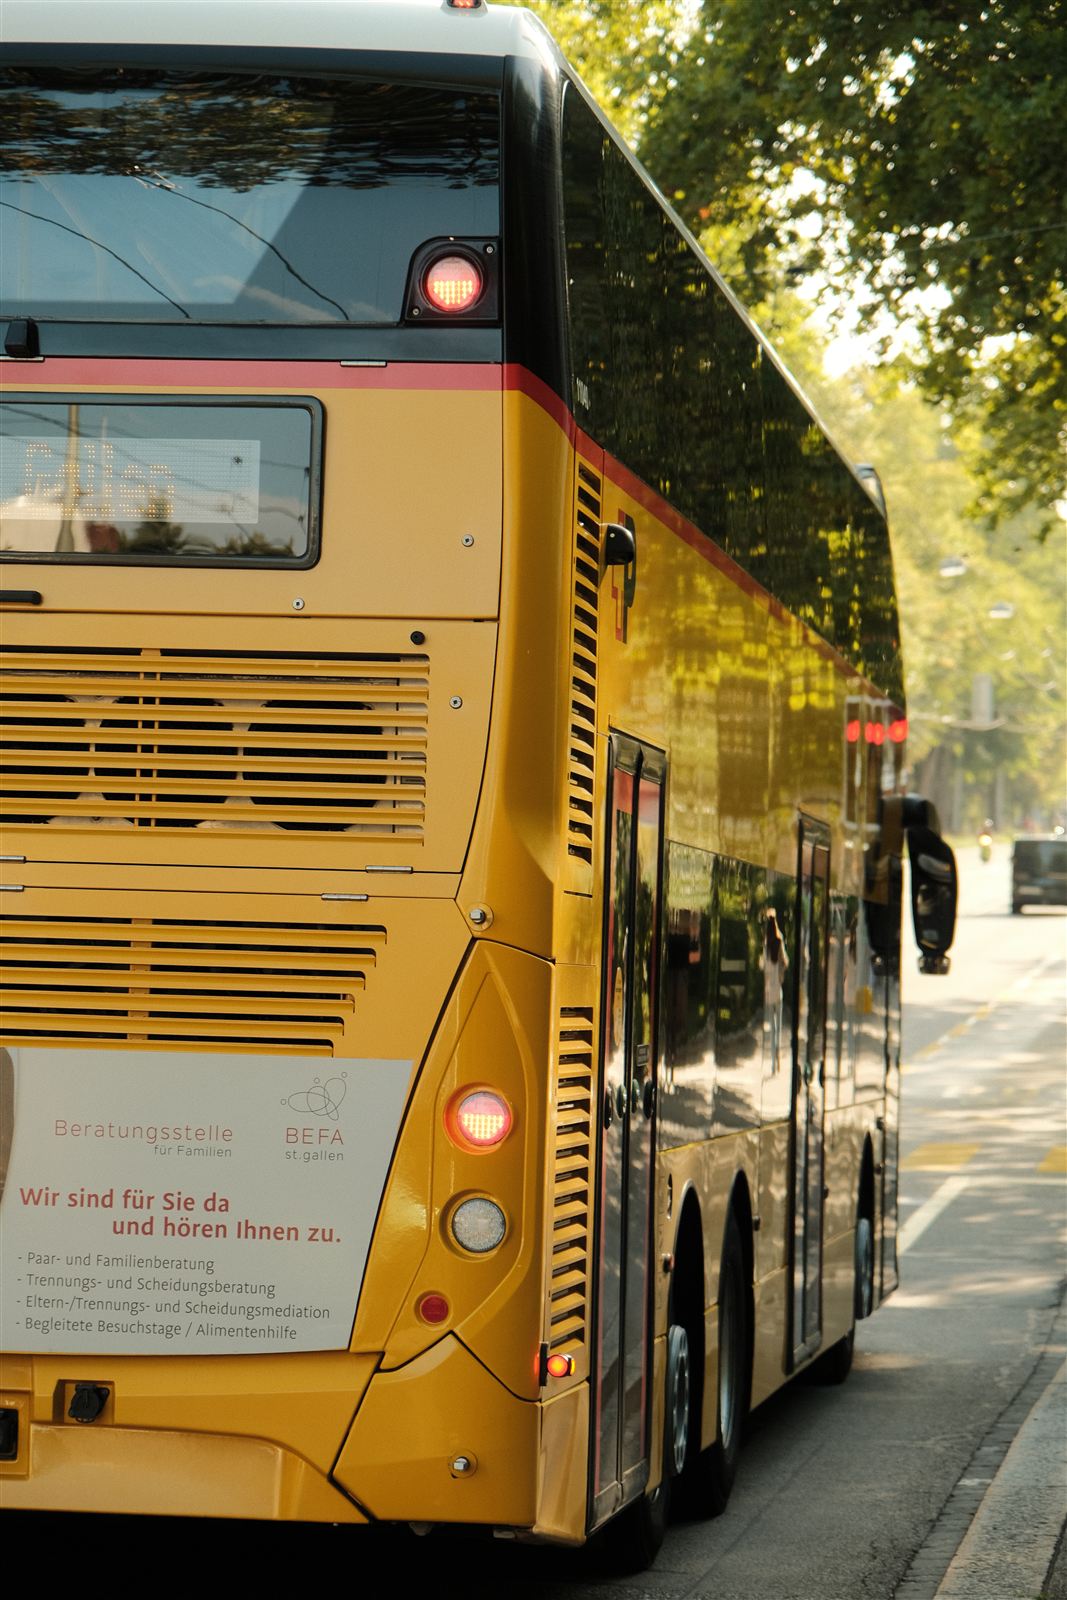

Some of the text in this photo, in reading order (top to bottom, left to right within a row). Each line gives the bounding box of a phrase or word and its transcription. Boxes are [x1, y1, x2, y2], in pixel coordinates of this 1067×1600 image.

[54, 1119, 233, 1143] Beratungsstelle
[286, 1127, 344, 1145] BEFA
[154, 1144, 232, 1158] für Familien
[19, 1187, 230, 1213] Wir sind für Sie da
[112, 1216, 341, 1243] und hören Ihnen zu.
[27, 1251, 61, 1265] Paar-
[66, 1253, 91, 1267] und
[96, 1254, 215, 1274] Familienberatung
[27, 1273, 102, 1291] Trennungs-
[107, 1276, 133, 1290] und
[137, 1277, 276, 1297] Scheidungsberatung
[155, 1299, 181, 1314] und
[185, 1300, 330, 1319] Scheidungsmediation
[25, 1317, 93, 1335] Begleitete
[98, 1320, 182, 1338] Besuchstage
[196, 1323, 297, 1340] Alimentenhilfe
